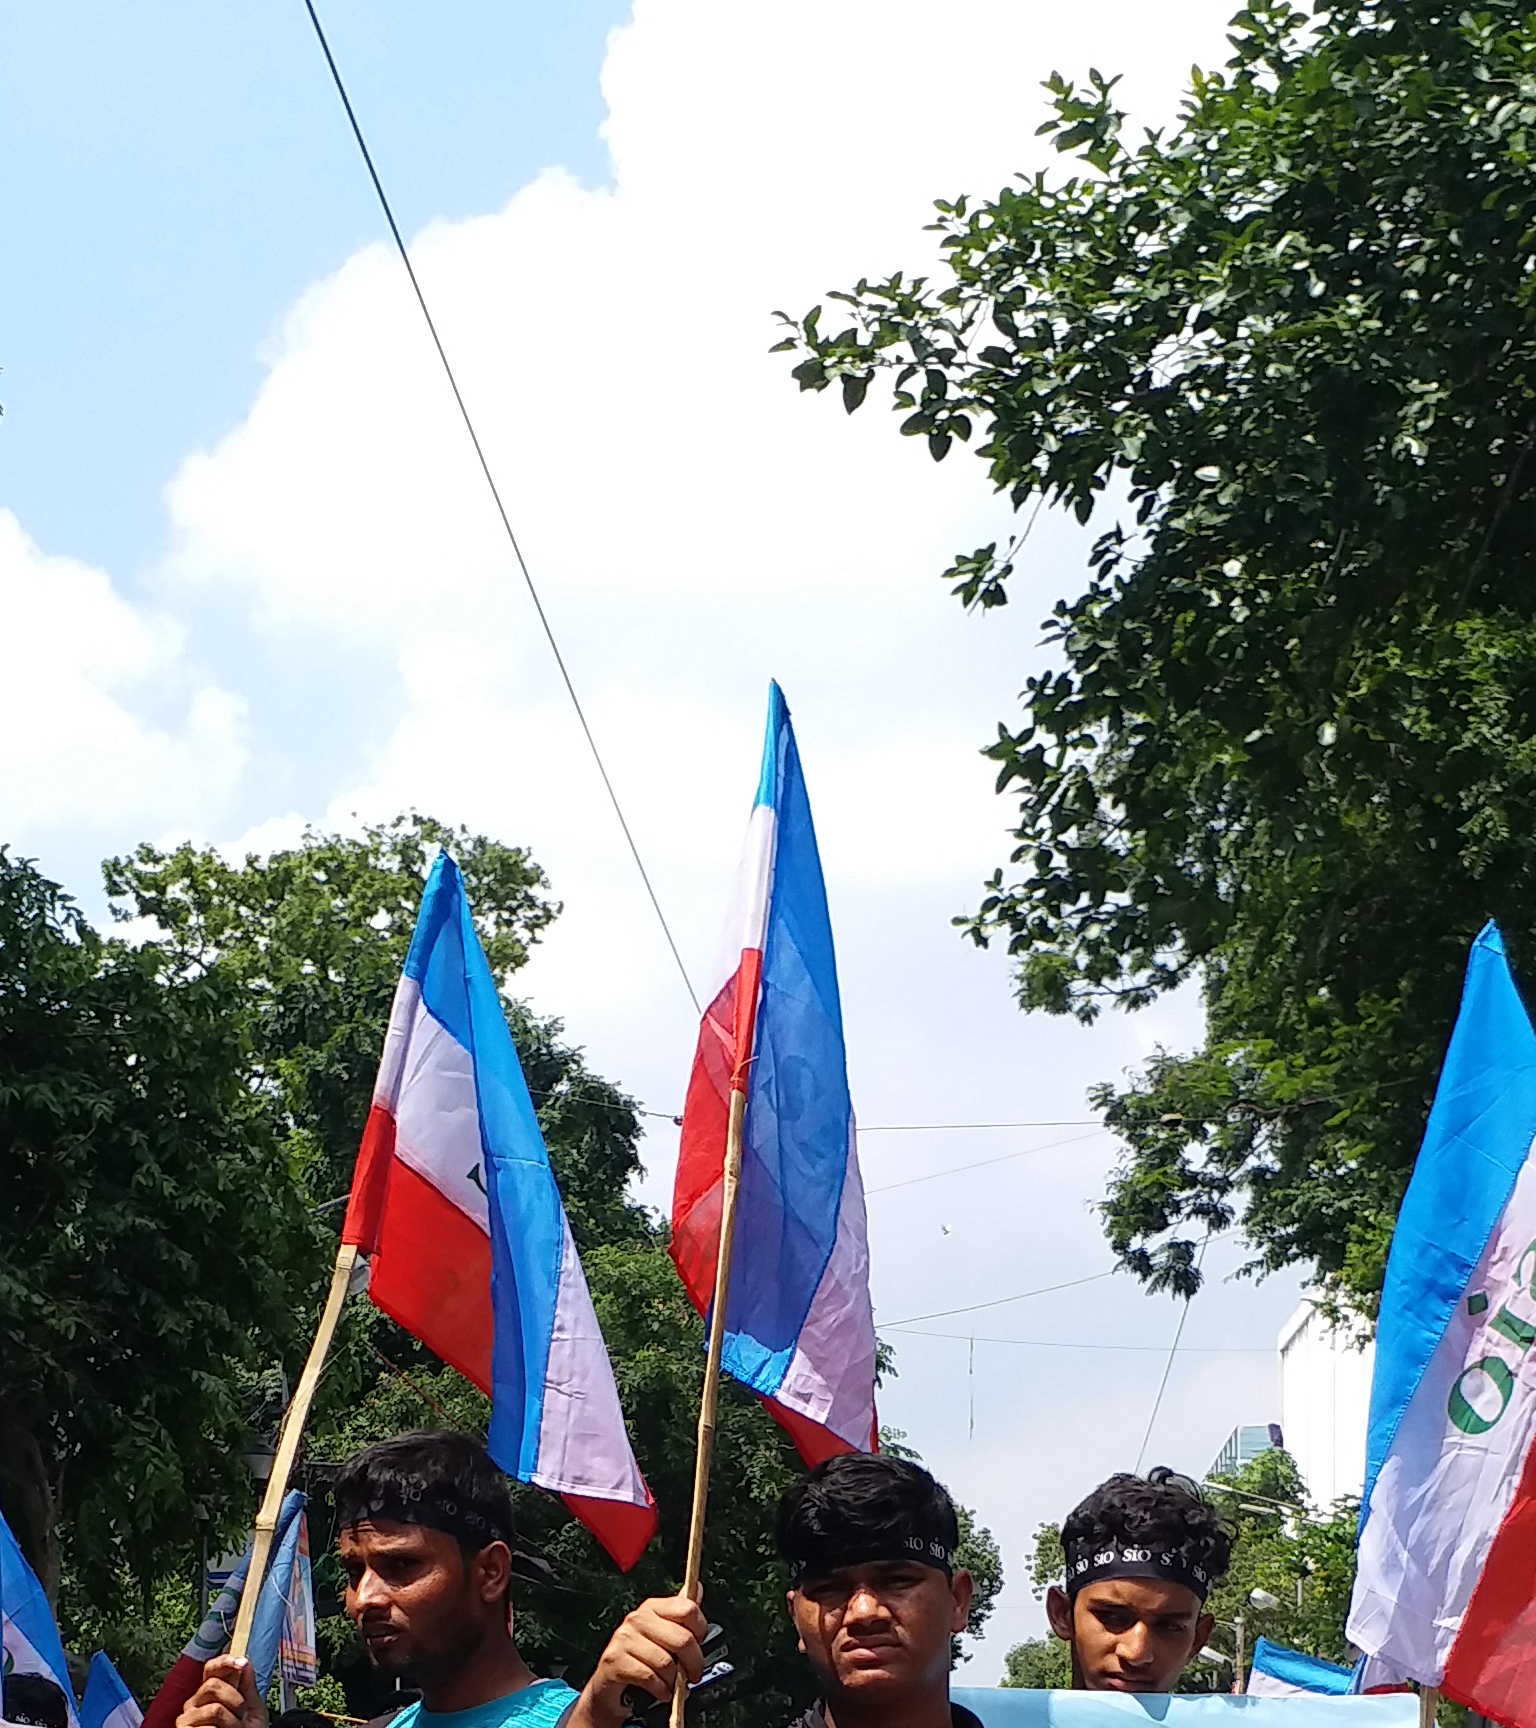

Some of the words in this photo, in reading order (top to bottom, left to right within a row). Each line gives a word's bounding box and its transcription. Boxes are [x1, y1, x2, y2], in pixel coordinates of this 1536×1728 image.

[930, 1536, 945, 1560] sio
[1076, 1554, 1089, 1575] sio
[1094, 1547, 1114, 1568] sio
[1122, 1543, 1152, 1562] sio
[1192, 1562, 1207, 1583] sio
